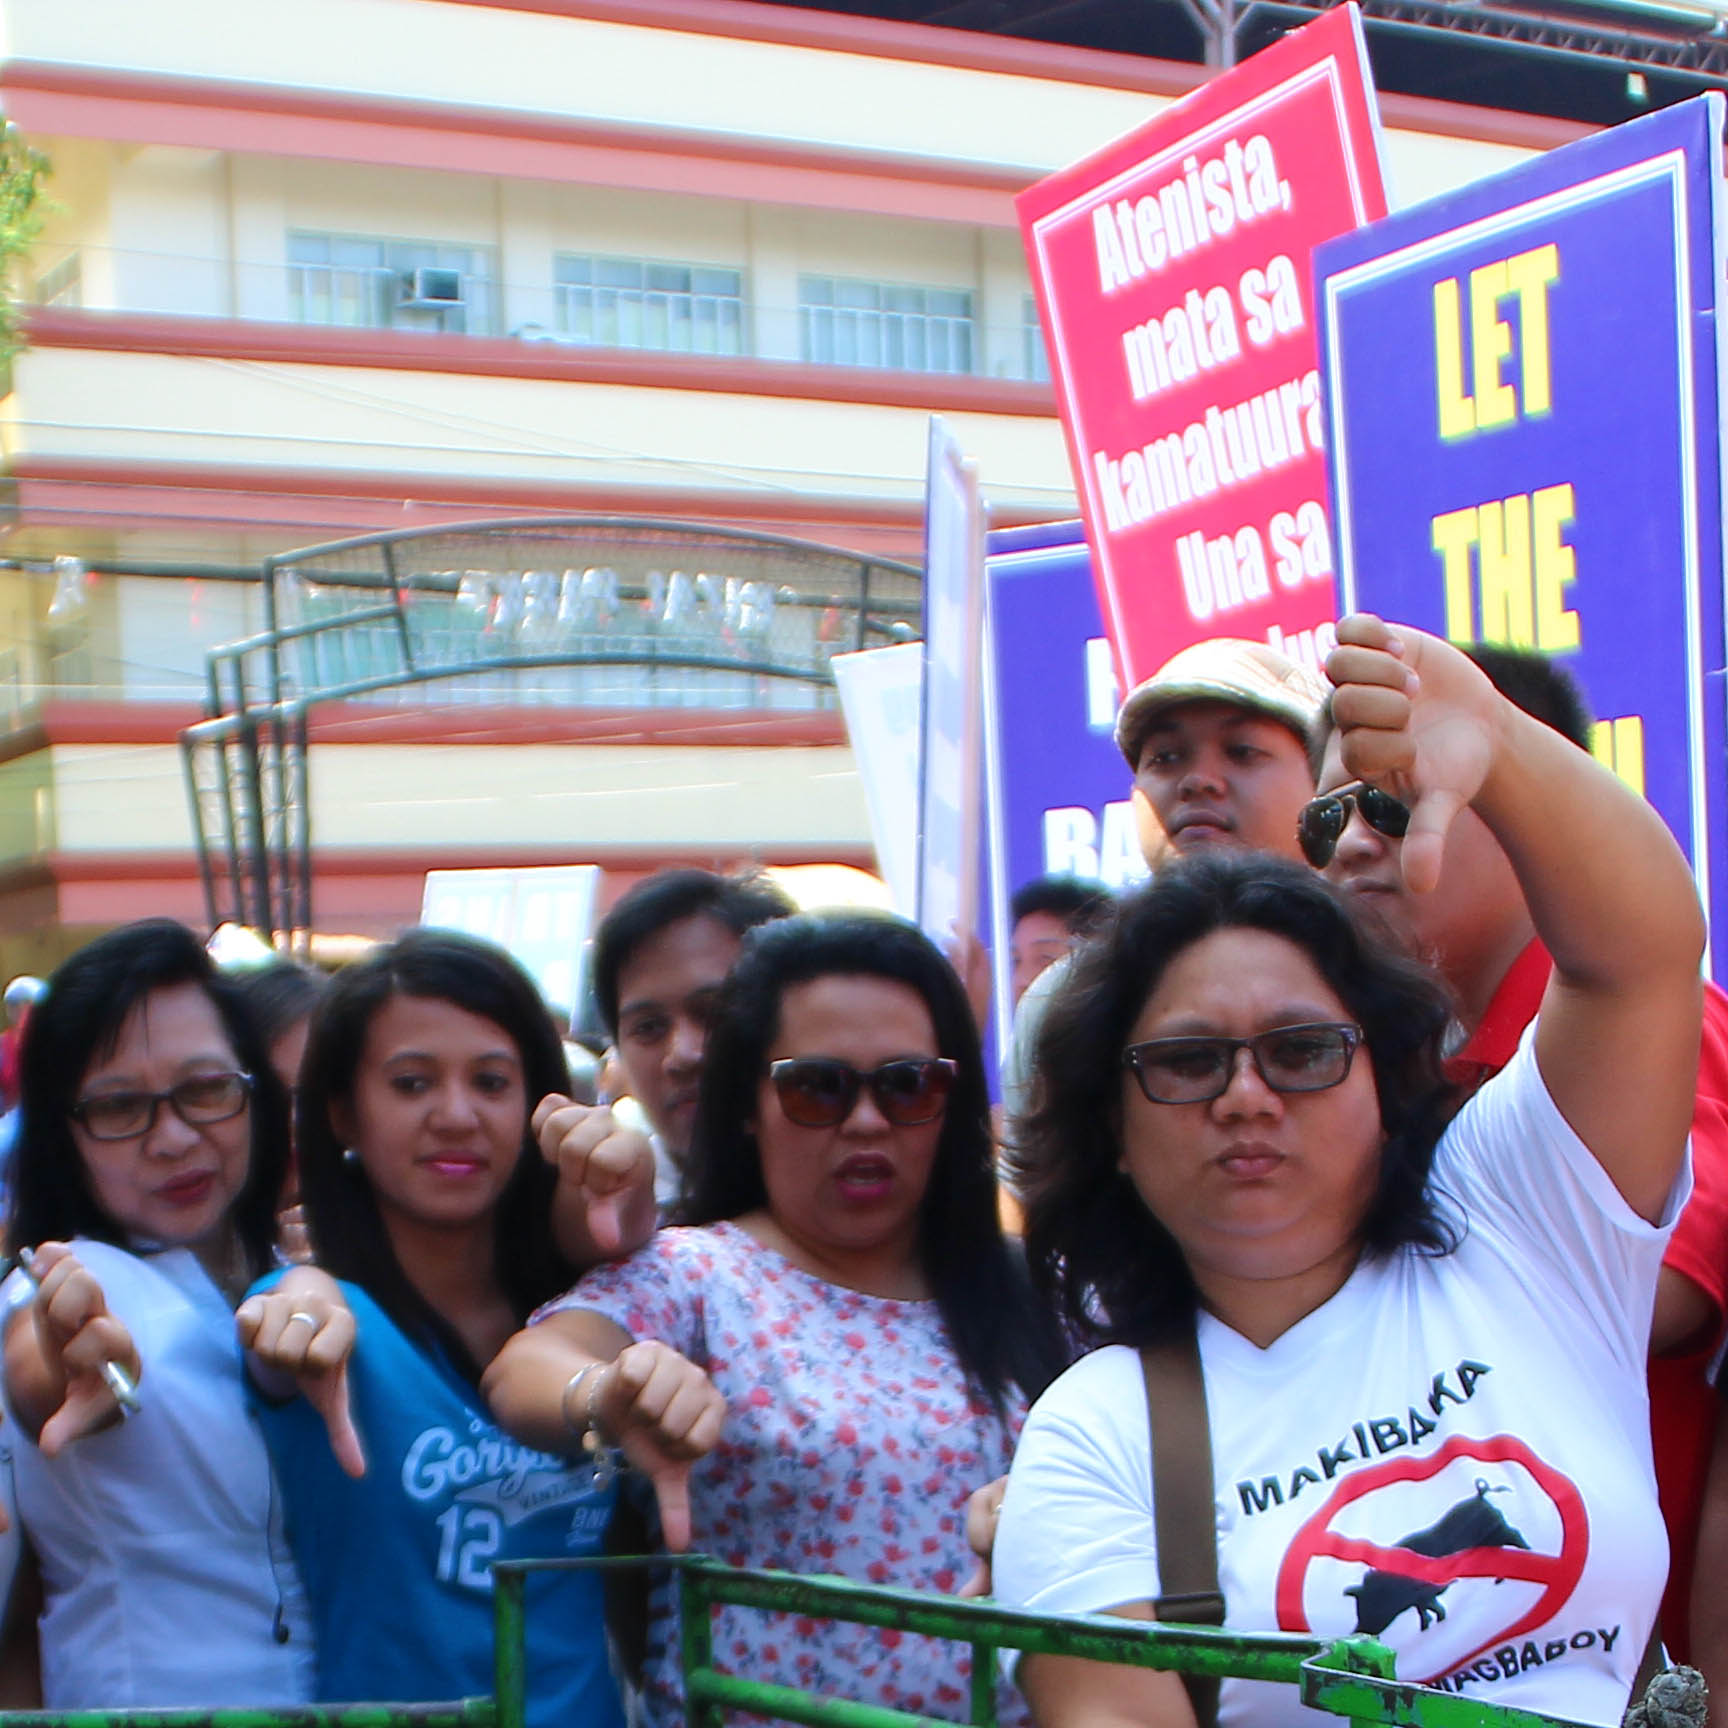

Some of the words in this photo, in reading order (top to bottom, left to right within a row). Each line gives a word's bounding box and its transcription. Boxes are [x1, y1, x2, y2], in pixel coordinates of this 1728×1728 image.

[1093, 134, 1291, 294] Atenista,
[1125, 285, 1241, 401] mata
[1238, 253, 1303, 350] sa
[1433, 245, 1559, 442] LET
[1093, 369, 1324, 532] kamatuura
[1177, 523, 1272, 620] Una
[1275, 499, 1332, 595] sa
[1432, 484, 1580, 651] THE
[1237, 1359, 1493, 1516] MAKIBAKA
[436, 1504, 503, 1592] 12
